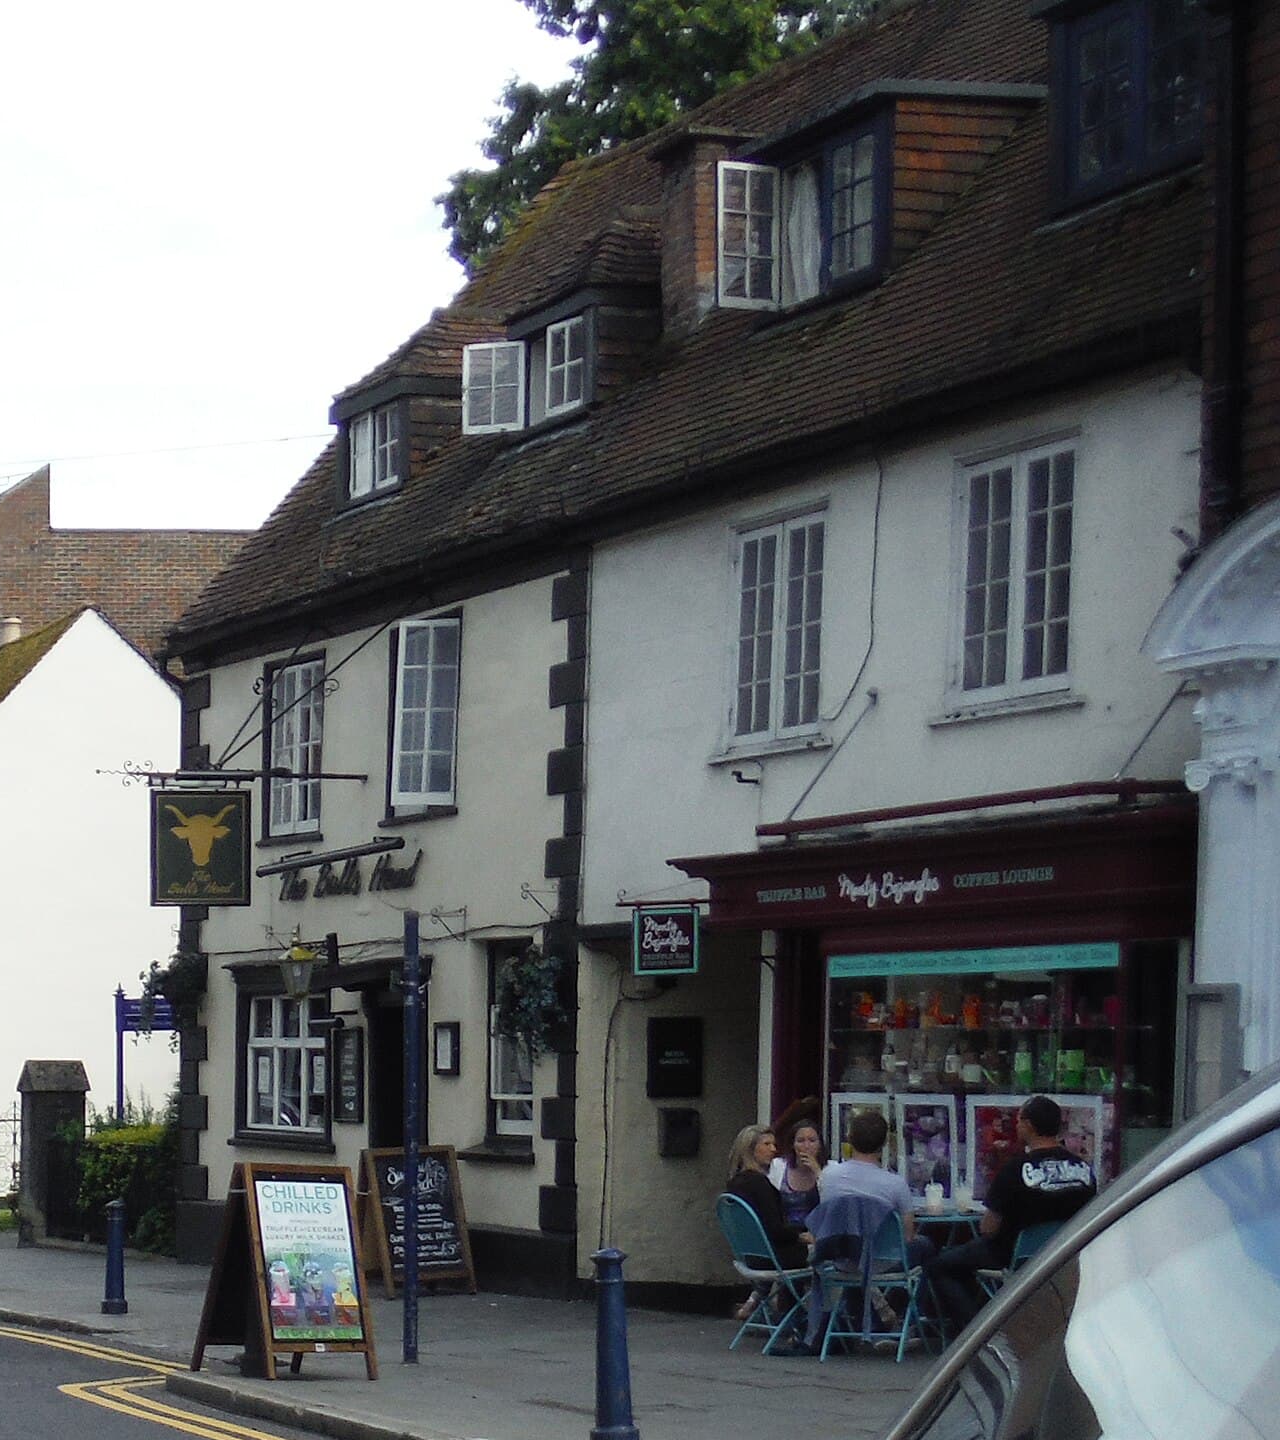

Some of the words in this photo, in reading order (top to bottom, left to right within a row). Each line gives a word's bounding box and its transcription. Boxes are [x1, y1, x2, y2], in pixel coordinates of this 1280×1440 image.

[953, 871, 999, 888] COFFEE
[1002, 866, 1054, 885] LOUNGE
[261, 1184, 338, 1200] CHILLED
[272, 1201, 332, 1214] DRINKS
